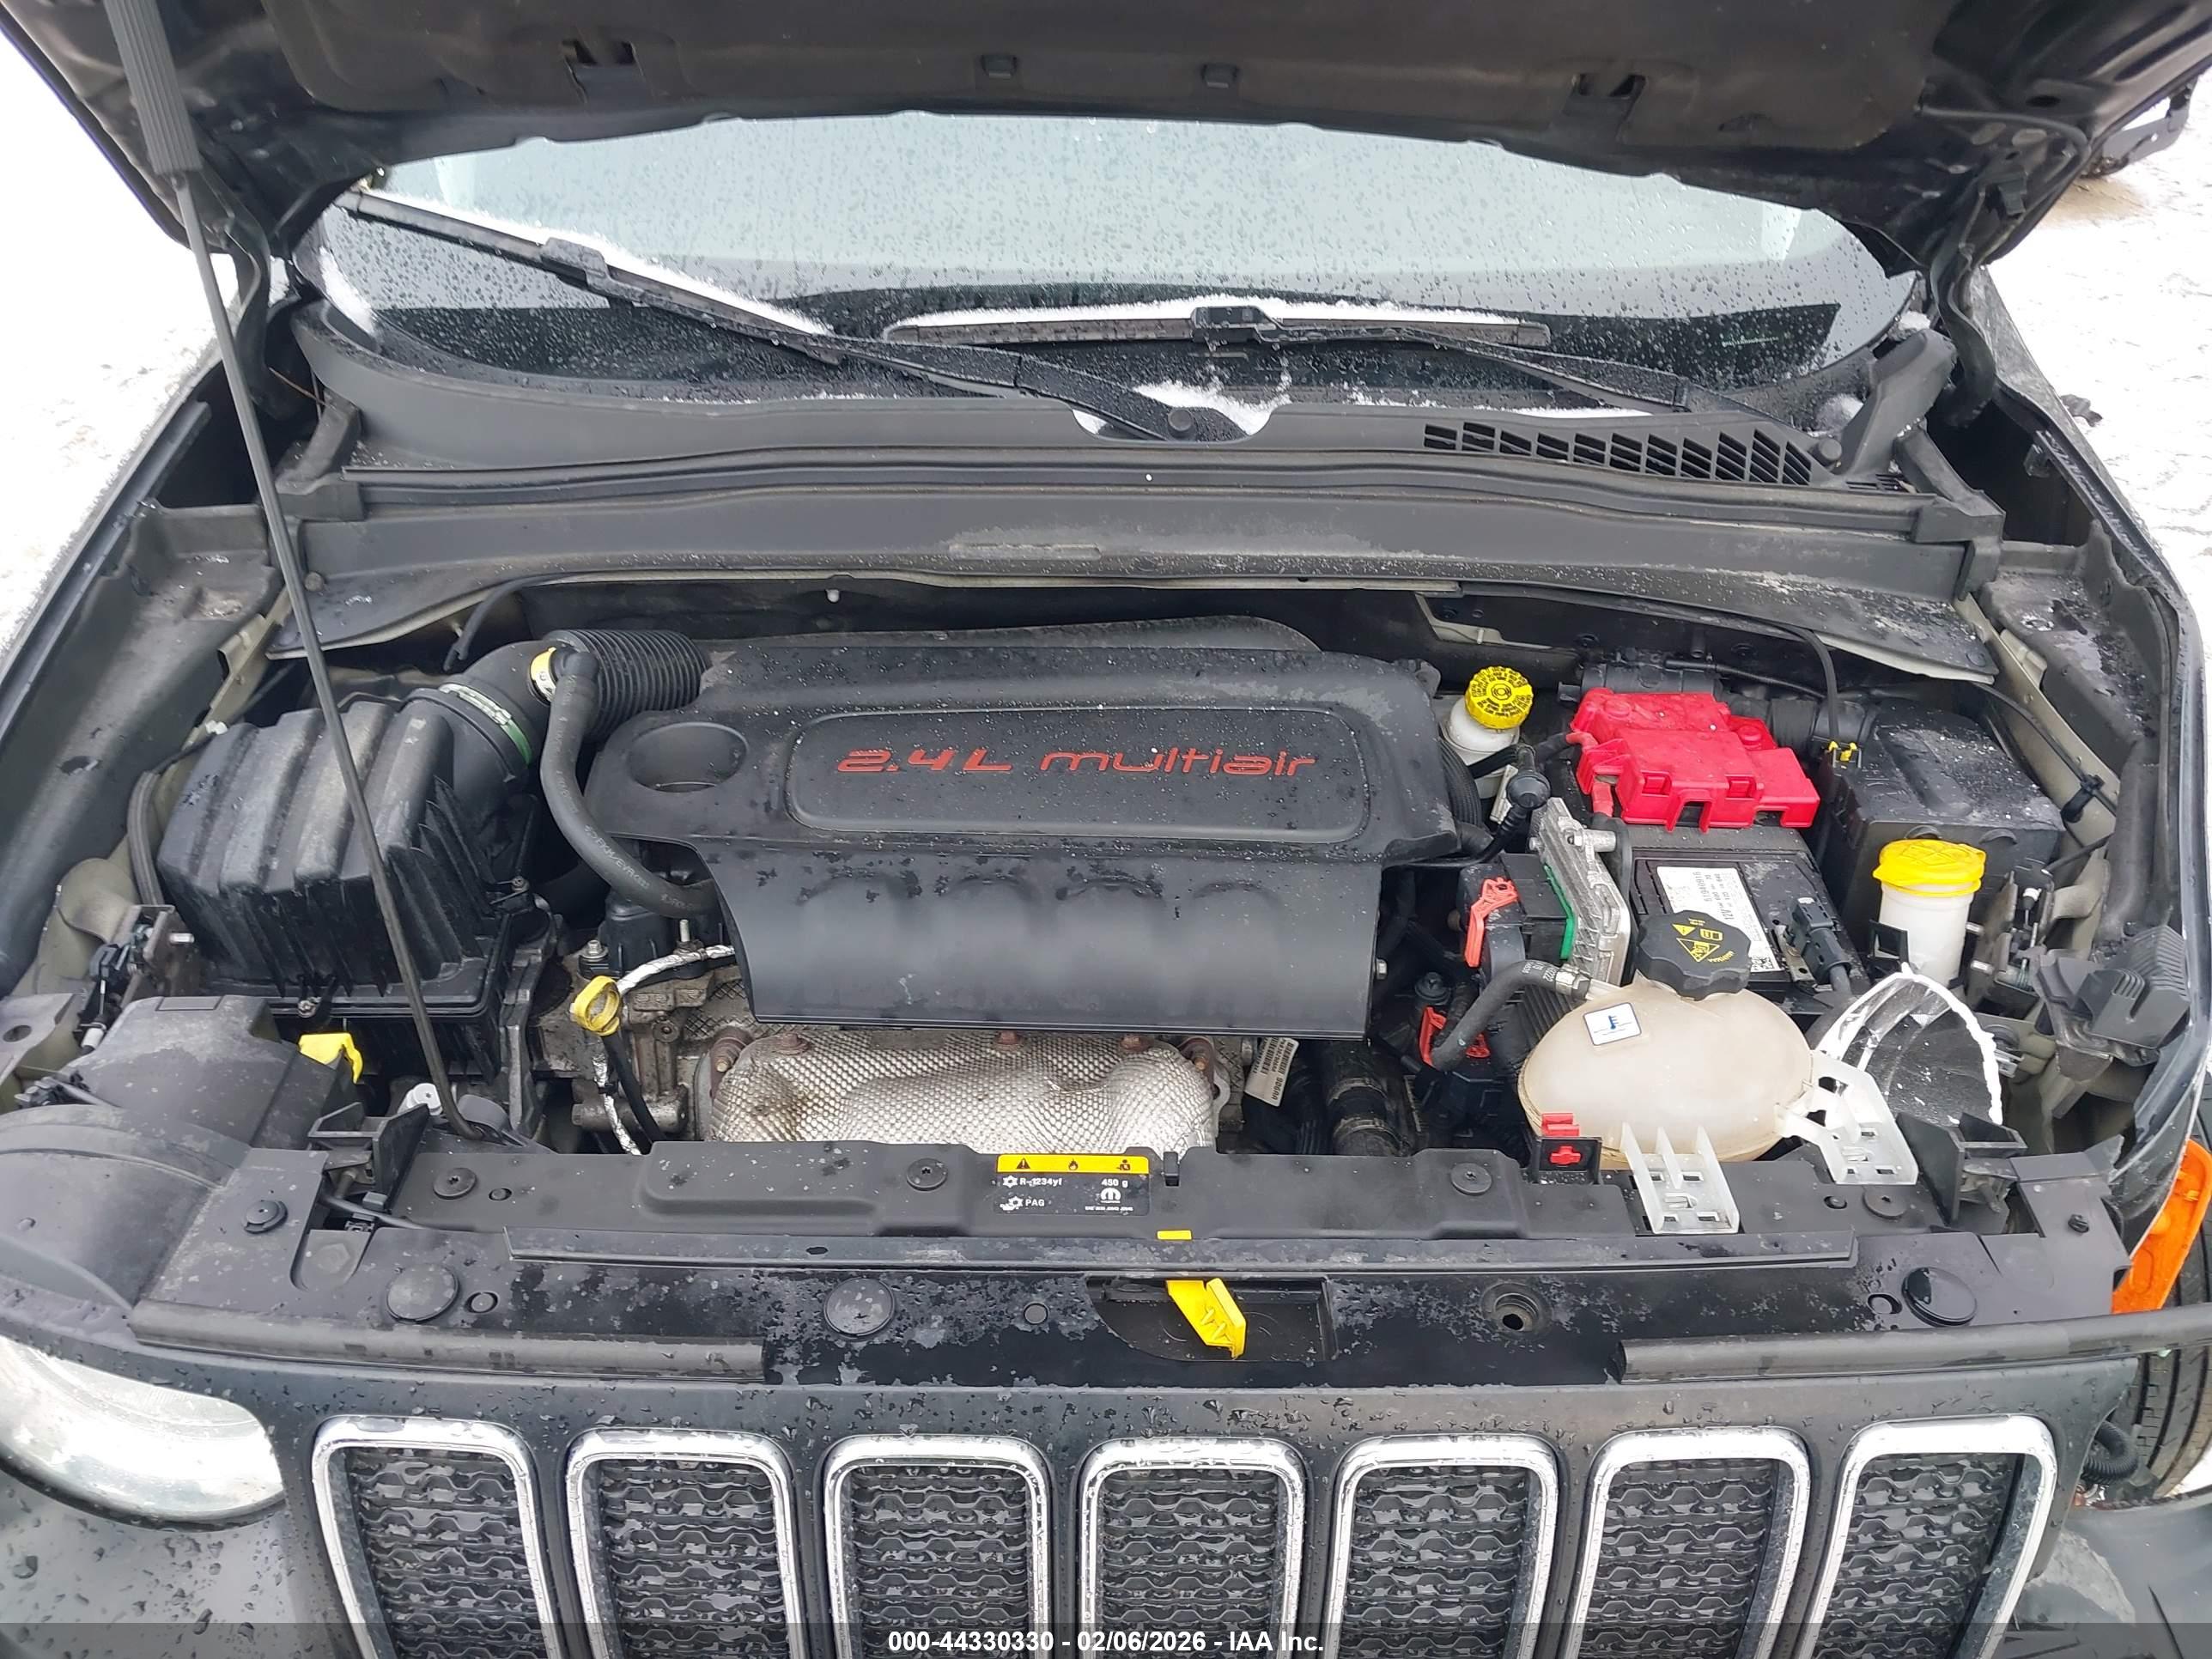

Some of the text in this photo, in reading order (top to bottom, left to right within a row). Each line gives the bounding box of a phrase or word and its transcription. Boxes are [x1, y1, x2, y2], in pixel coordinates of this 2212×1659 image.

[1039, 747, 1315, 776] multiair
[1101, 1178, 1119, 1187] 450
[1025, 1198, 1045, 1207] PAG
